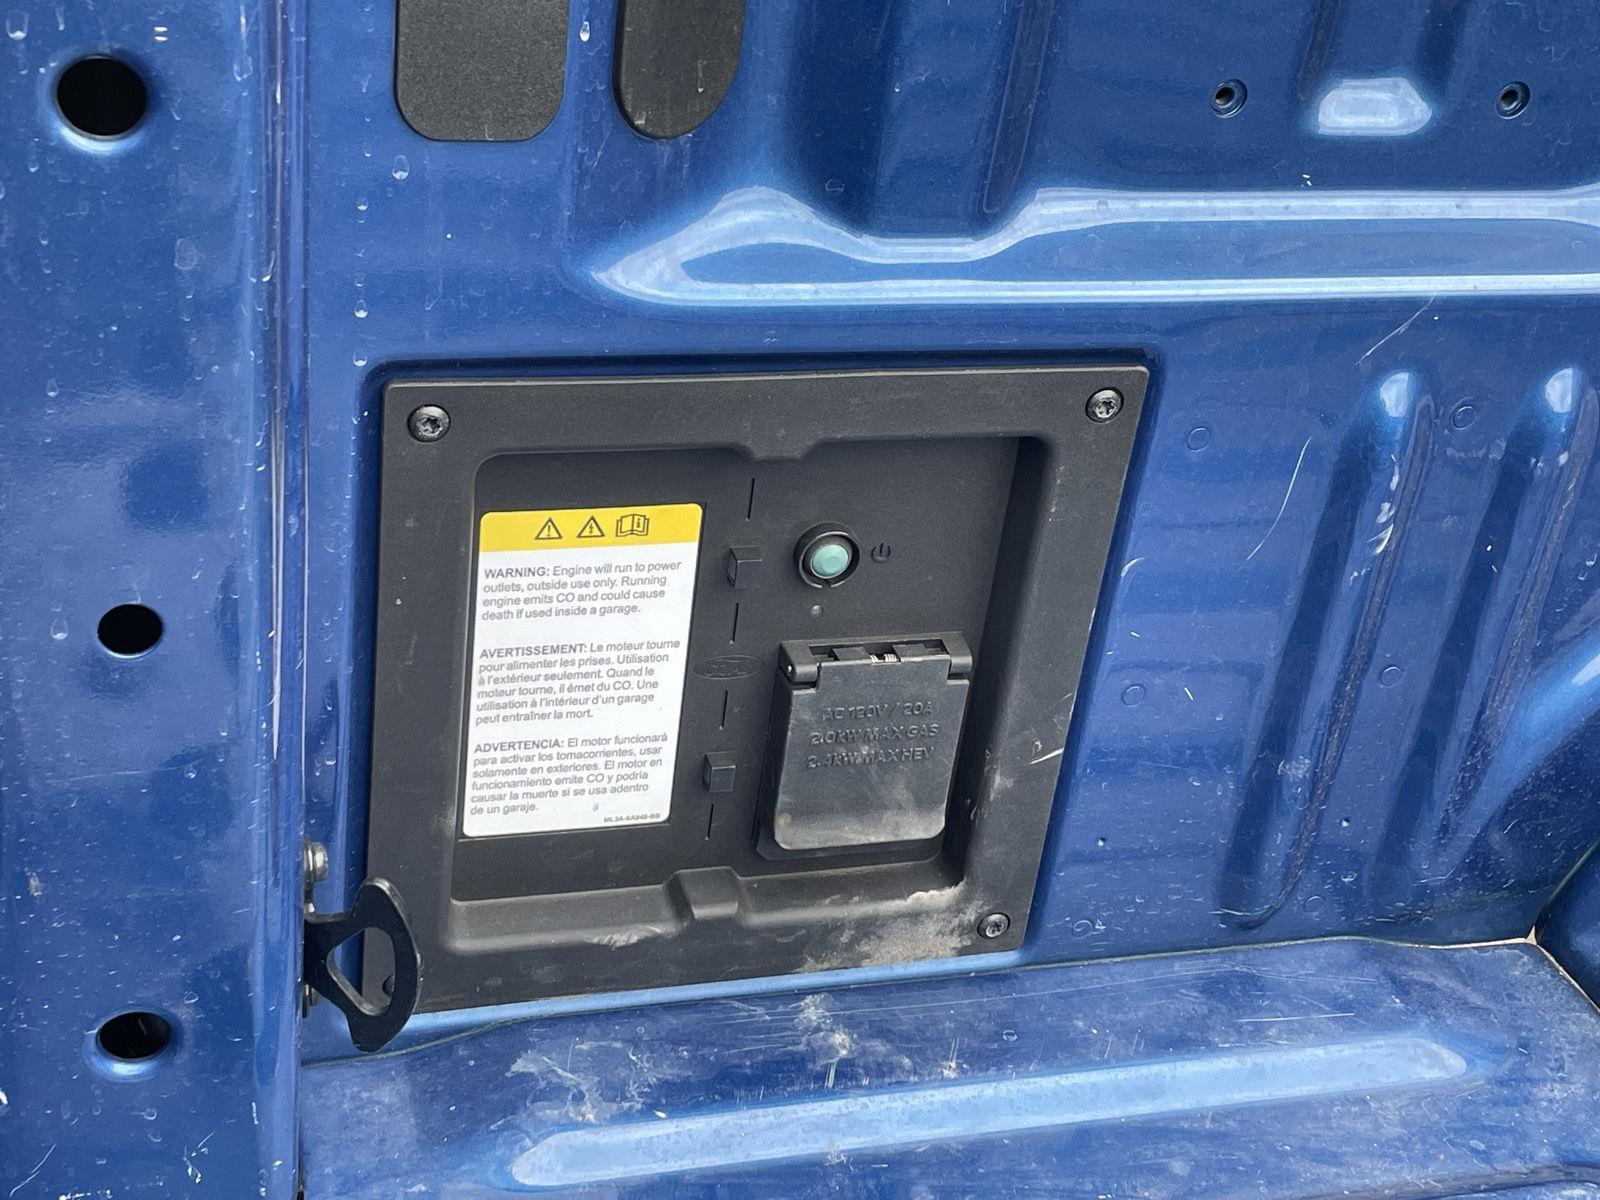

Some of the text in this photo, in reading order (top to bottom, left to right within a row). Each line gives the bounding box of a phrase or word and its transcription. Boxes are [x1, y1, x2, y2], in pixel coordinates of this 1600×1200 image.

[485, 562, 682, 579] WARNING: Engine will run to power
[484, 575, 667, 593] outlets, outside use only. Running
[482, 589, 665, 608] engine emits CO and could cause
[482, 604, 641, 620] death if used inside a garage.
[480, 640, 680, 659] AVERTISSEMENT: Le moteur tourne
[479, 653, 669, 674] pour alimenter les prises. Utilisation
[479, 666, 654, 686] à l'extérieur seulement. Quand le
[477, 679, 659, 698] moteur tourne, il émet du CO. Une
[477, 693, 654, 712] utilisation à l'intérieur d'un garage
[476, 709, 593, 726] peut entraîner la mort.
[474, 733, 667, 753] ADVERTENCIA: El motor funcionará
[474, 746, 662, 767] para activar los tomacorrientes, usar
[473, 759, 662, 778] solamente en exteriores. El motor en
[472, 771, 648, 790] funcionamiento emite CO y podría
[471, 783, 649, 803] causar la muerte si se usa adentro
[471, 802, 538, 815] de un garaje.
